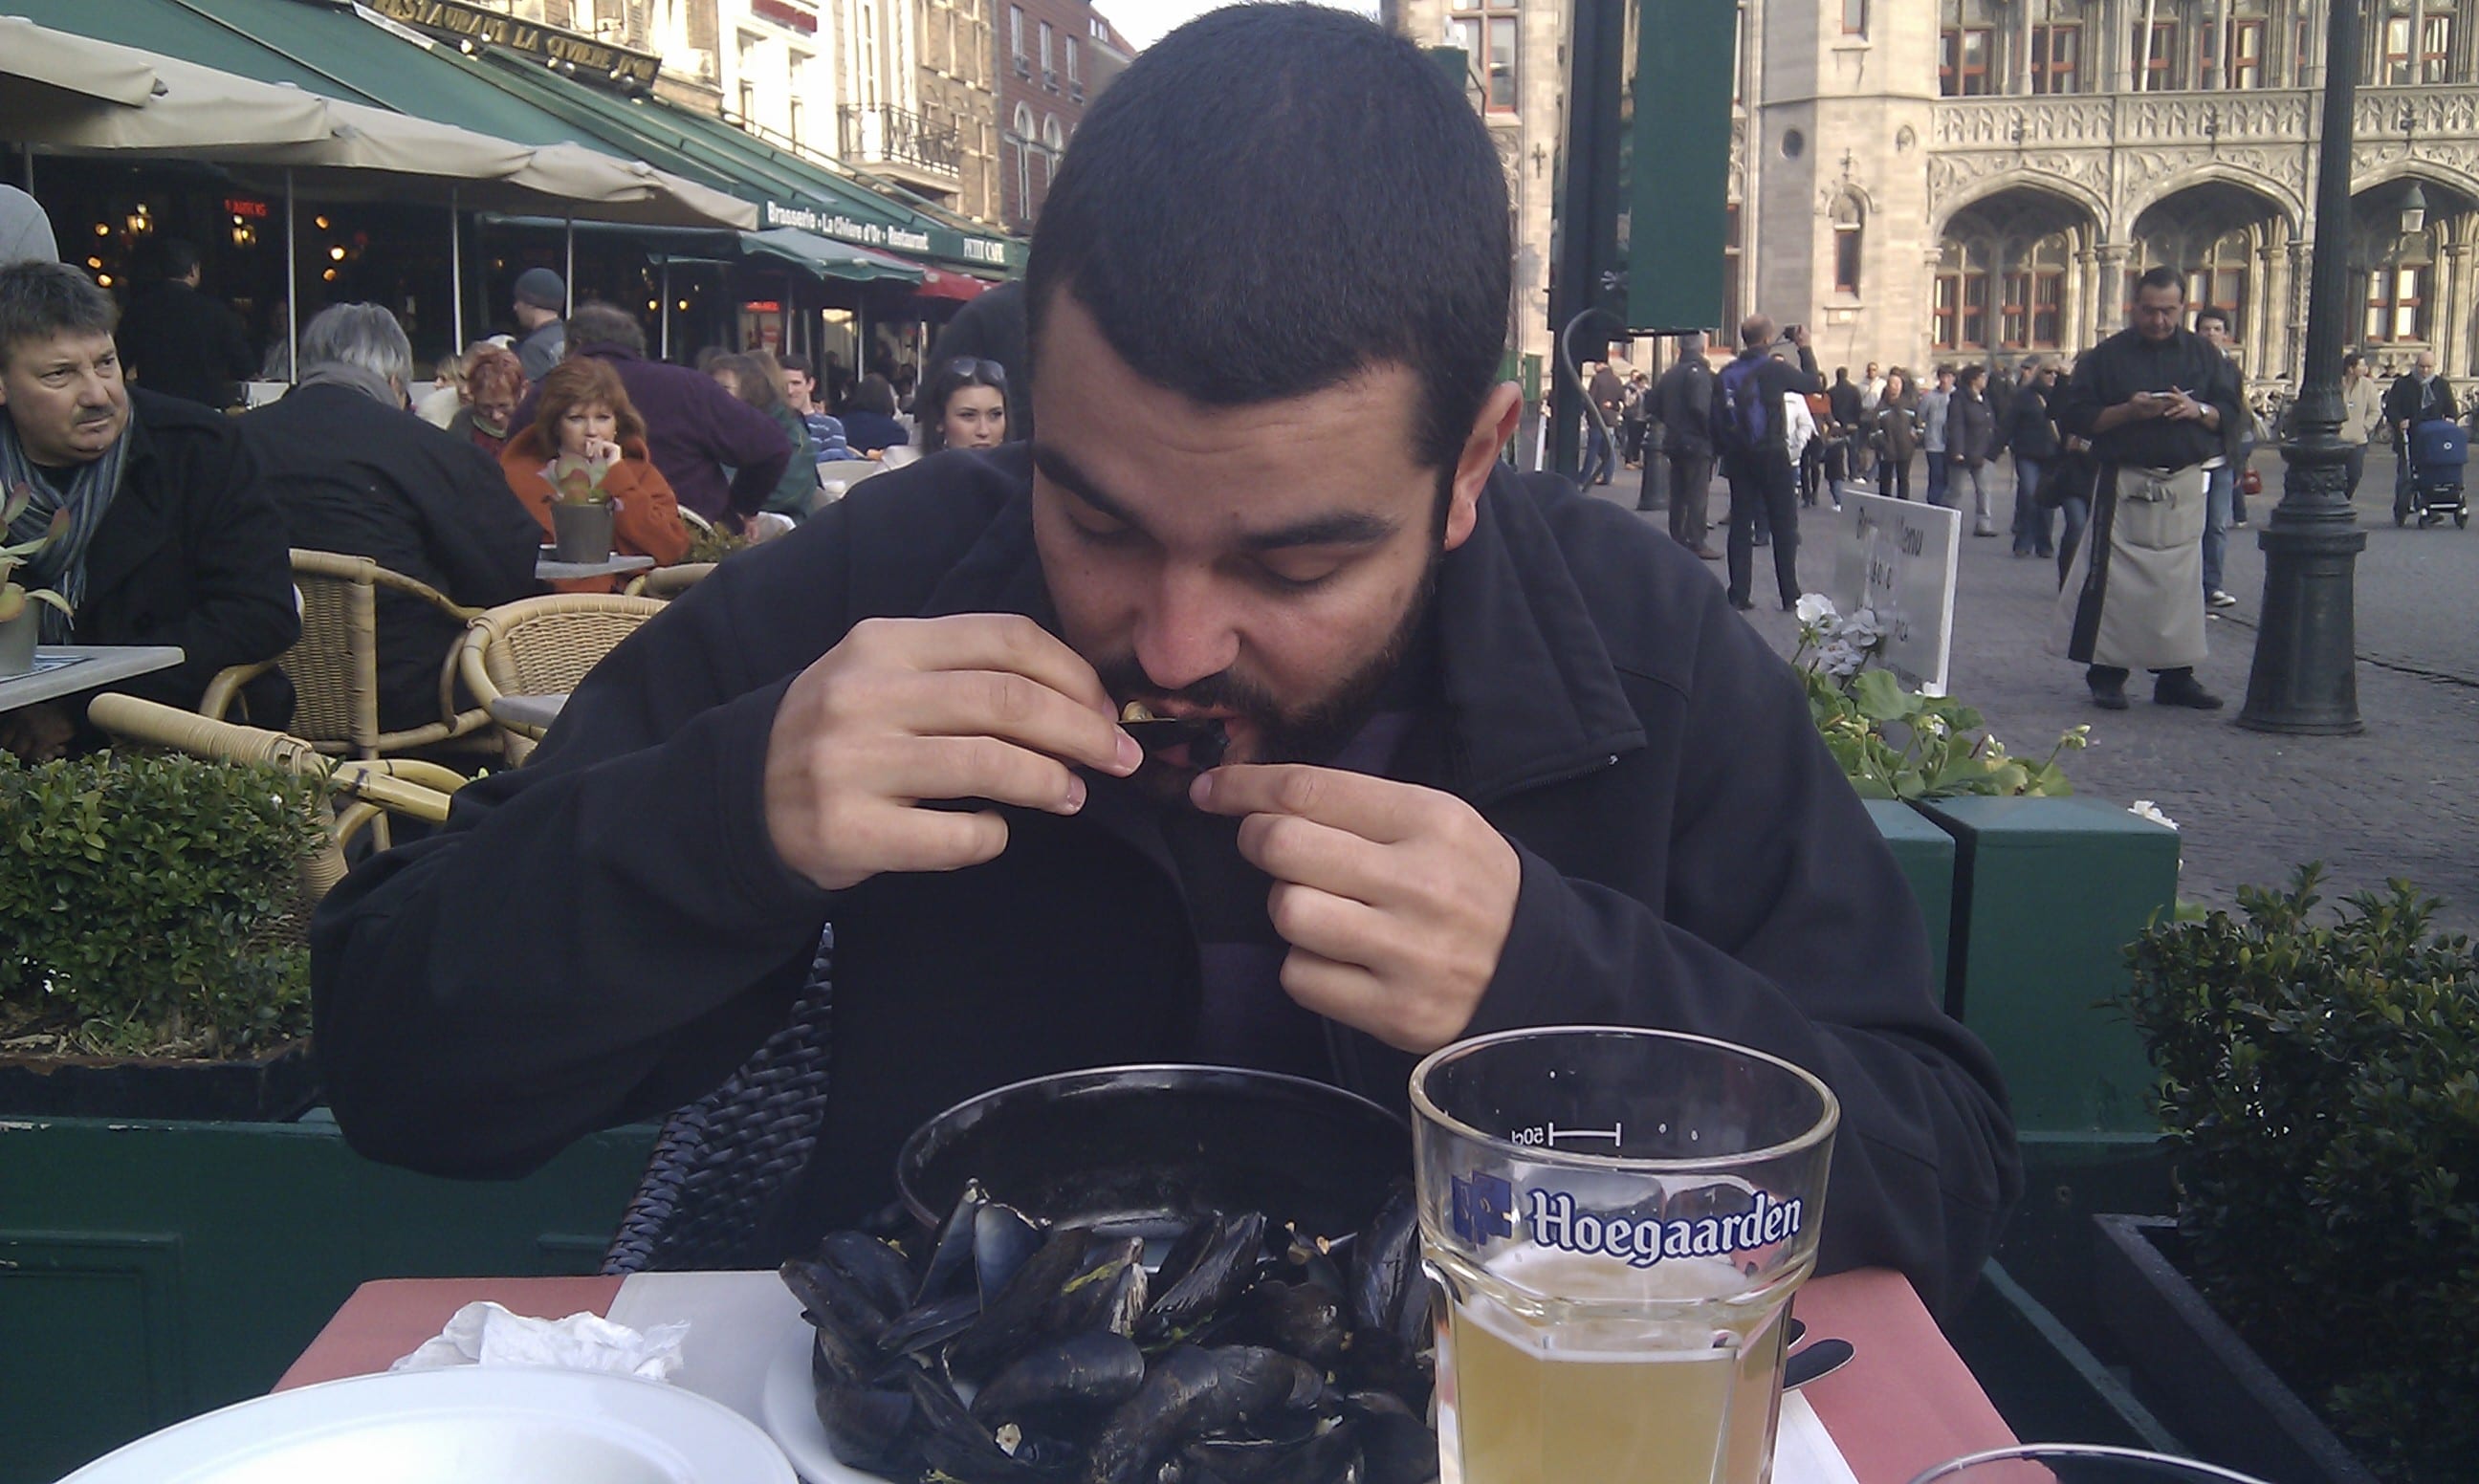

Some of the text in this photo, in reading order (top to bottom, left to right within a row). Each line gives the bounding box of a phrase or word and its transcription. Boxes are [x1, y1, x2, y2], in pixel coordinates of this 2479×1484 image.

[512, 26, 538, 51] LA
[767, 200, 816, 229] Brasserie
[822, 212, 834, 233] La
[888, 225, 930, 251] Restaurant
[1528, 1189, 1803, 1267] Hoegaarden
